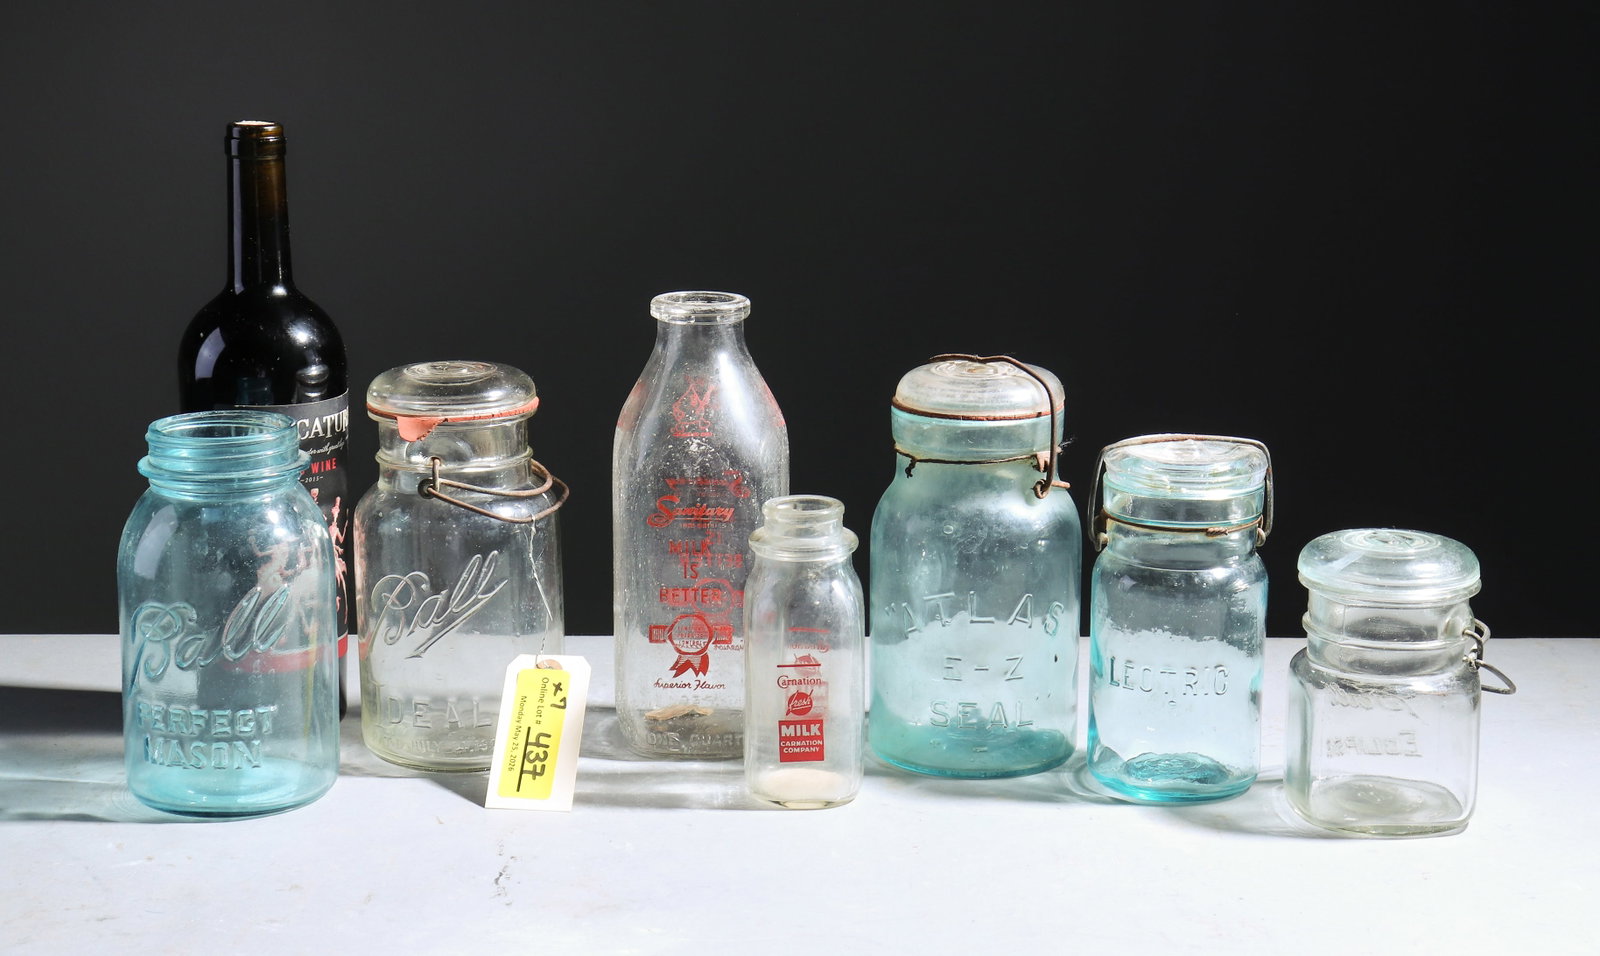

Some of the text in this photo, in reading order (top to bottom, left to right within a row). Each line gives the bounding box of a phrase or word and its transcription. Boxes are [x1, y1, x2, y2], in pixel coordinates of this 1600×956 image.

[311, 457, 337, 475] WINE
[646, 495, 735, 528] Sanitary
[669, 539, 711, 556] MILK
[683, 561, 699, 579] IS
[367, 550, 508, 659] Ball
[659, 588, 722, 603] BETTER
[130, 585, 290, 690] Ball
[777, 675, 822, 689] Carnation
[943, 656, 1024, 682] E-Z
[1109, 655, 1229, 697] LECTRIC
[539, 677, 550, 704] Online
[653, 677, 726, 691] Superior Flavor
[371, 680, 493, 729] IDEAL
[536, 705, 545, 719] Lot
[785, 689, 814, 716] fresh
[930, 700, 1033, 729] SEAL
[137, 701, 279, 737] PERFECT
[781, 724, 821, 737] MILK
[508, 695, 527, 772] Monday May 25, 2026
[780, 739, 823, 747] CARNATION
[144, 734, 264, 770] MASON
[522, 732, 552, 781] 437
[783, 746, 820, 754] COMPANY
